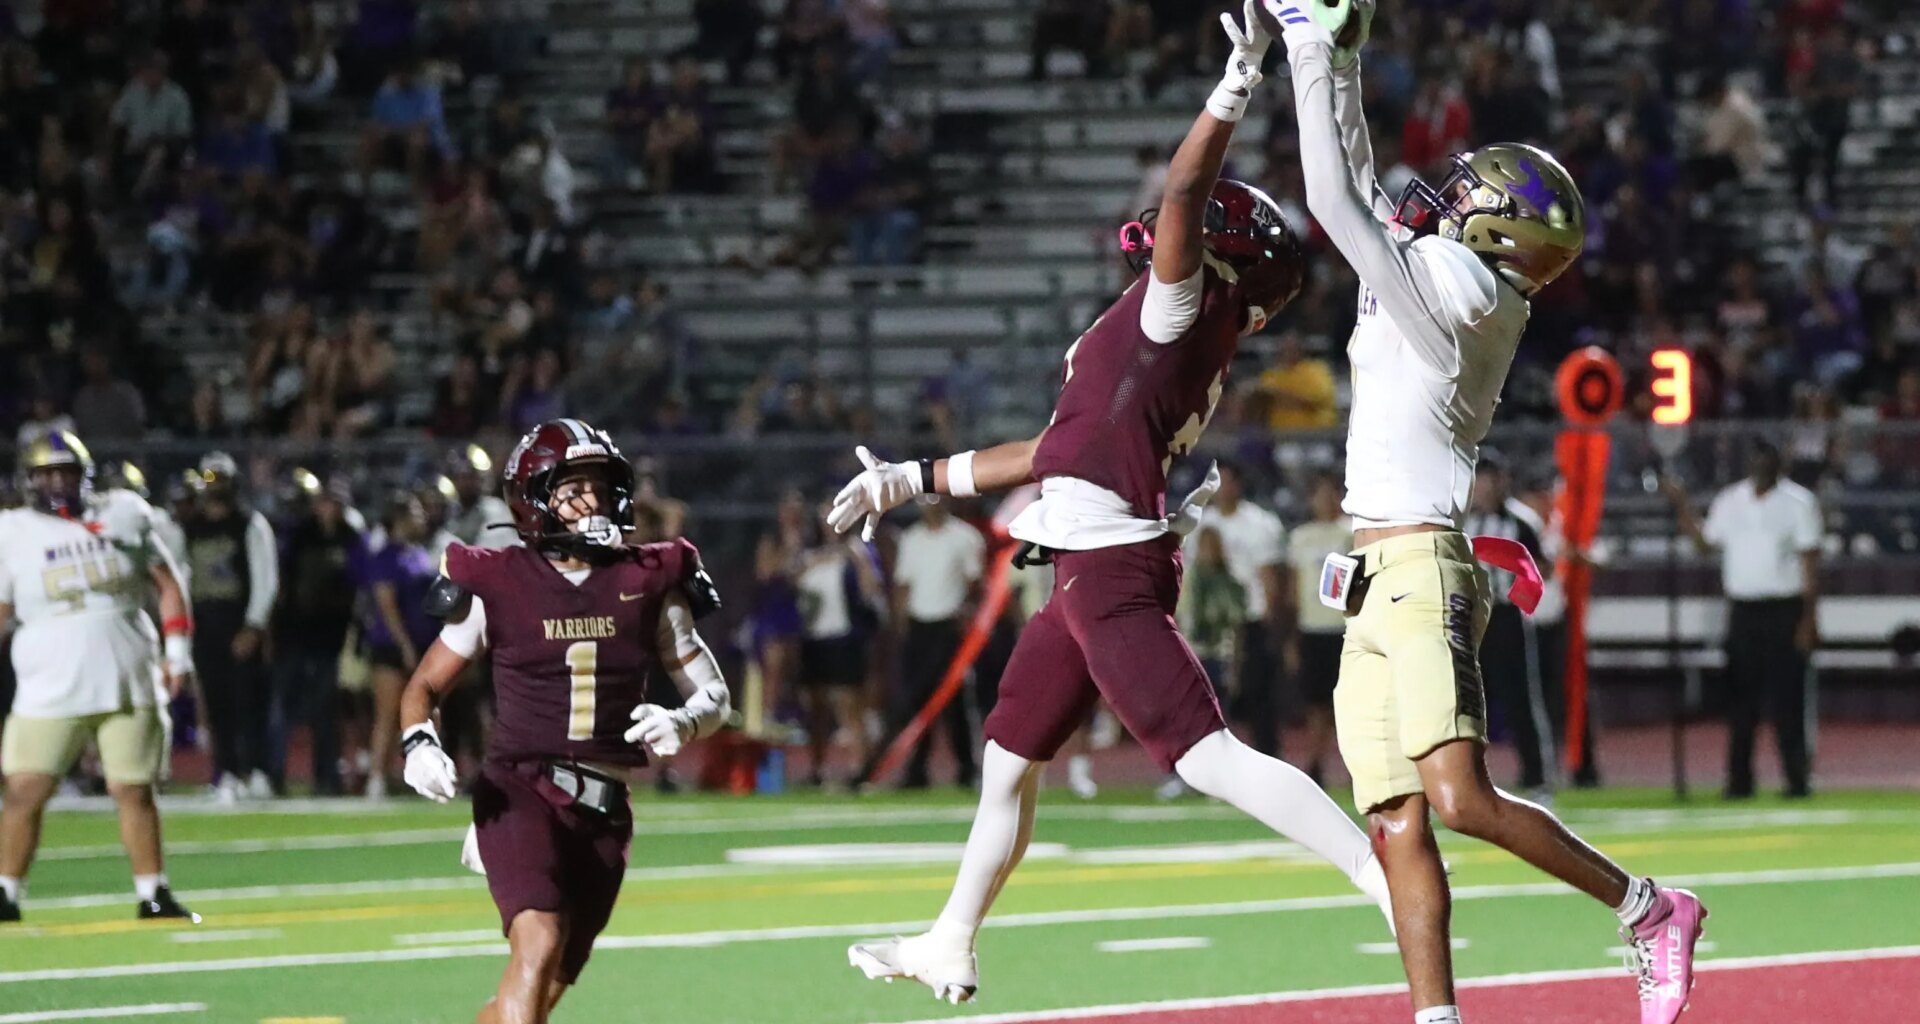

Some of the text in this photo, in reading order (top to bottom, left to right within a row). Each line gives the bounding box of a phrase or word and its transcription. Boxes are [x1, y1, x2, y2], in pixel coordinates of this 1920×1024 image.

[1651, 350, 1692, 425] 3
[42, 558, 121, 615] 54
[542, 616, 616, 640] WARRIORS
[565, 641, 597, 741] 1
[1667, 925, 1682, 999] BATTLE
